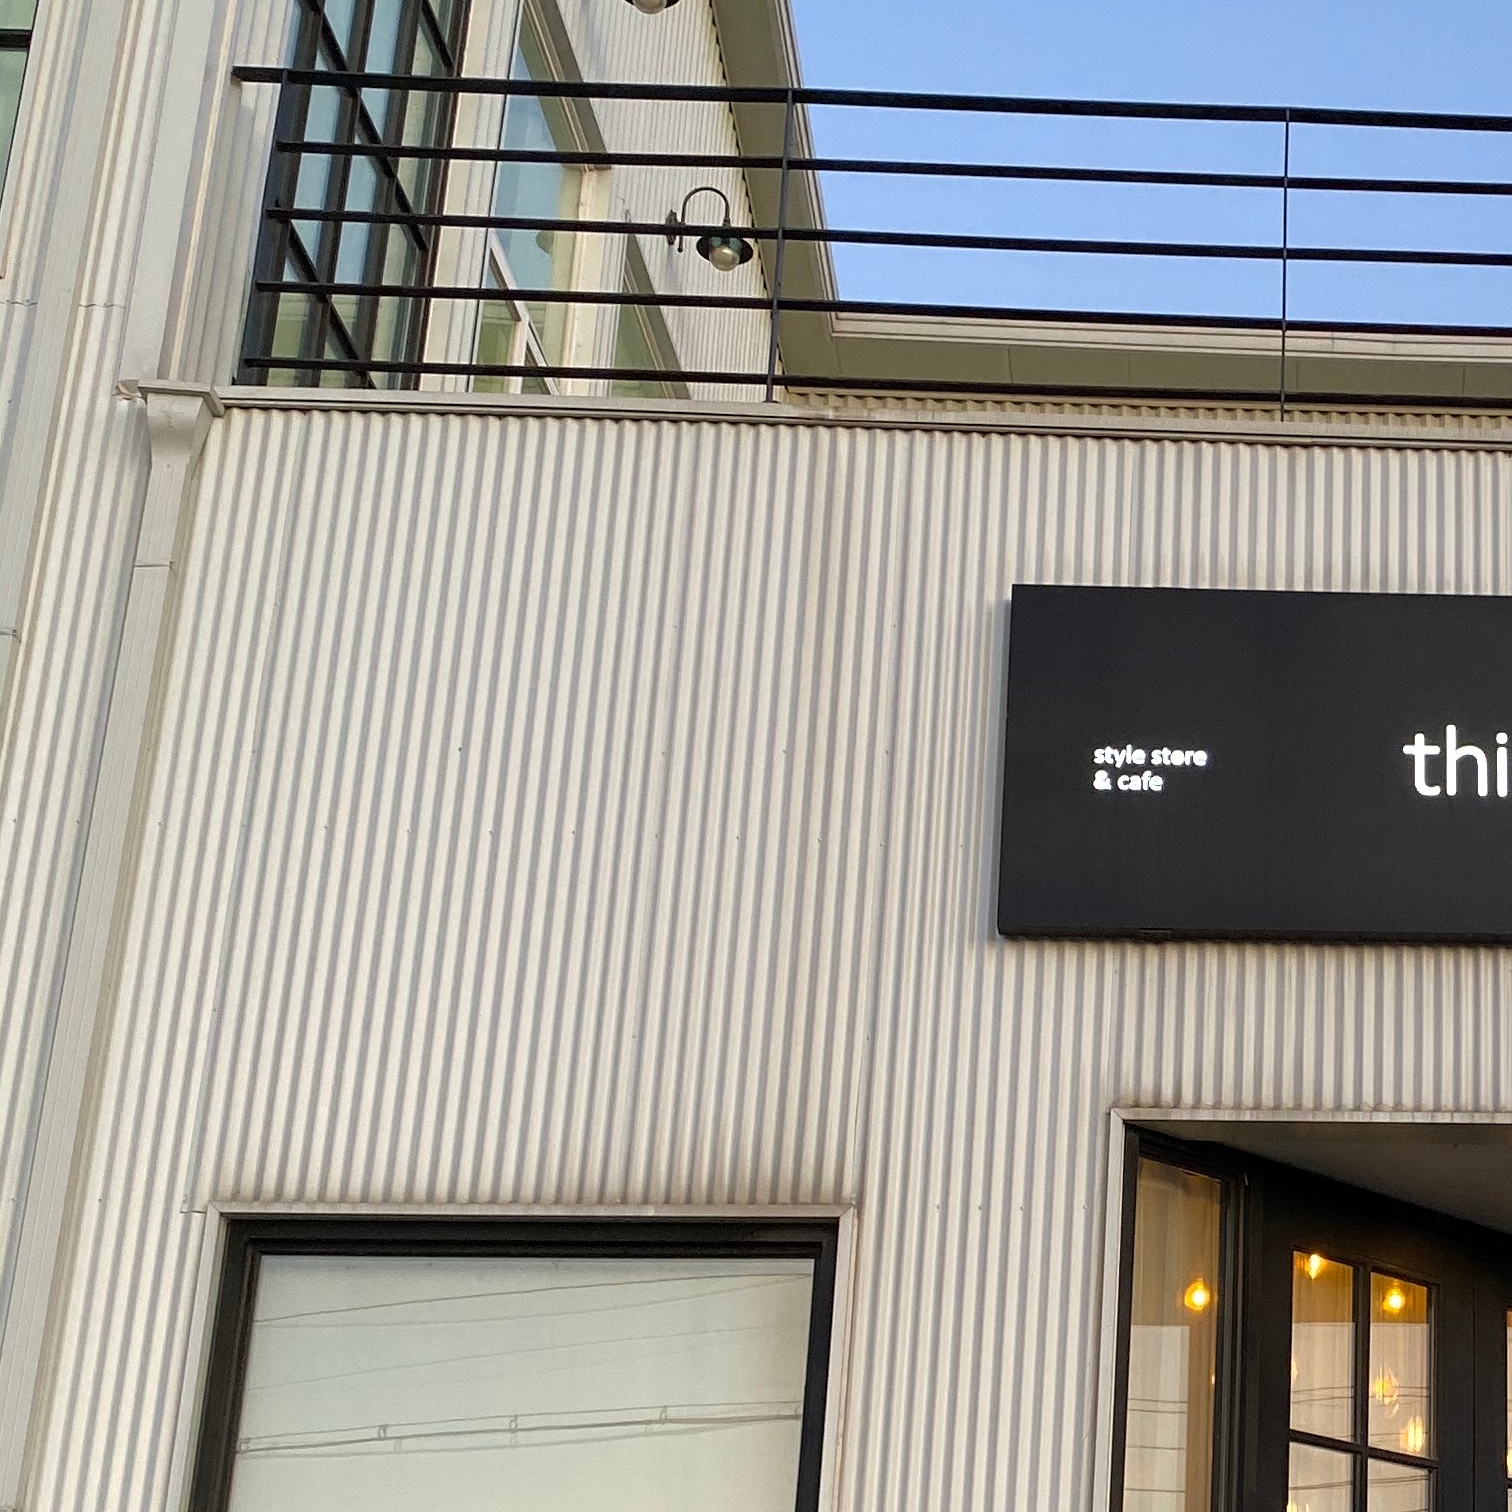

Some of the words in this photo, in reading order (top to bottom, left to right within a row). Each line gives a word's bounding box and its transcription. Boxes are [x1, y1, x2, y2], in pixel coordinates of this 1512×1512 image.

[1093, 744, 1147, 768] style
[1150, 747, 1208, 767] store
[1092, 769, 1112, 791] &
[1117, 769, 1164, 791] cafe
